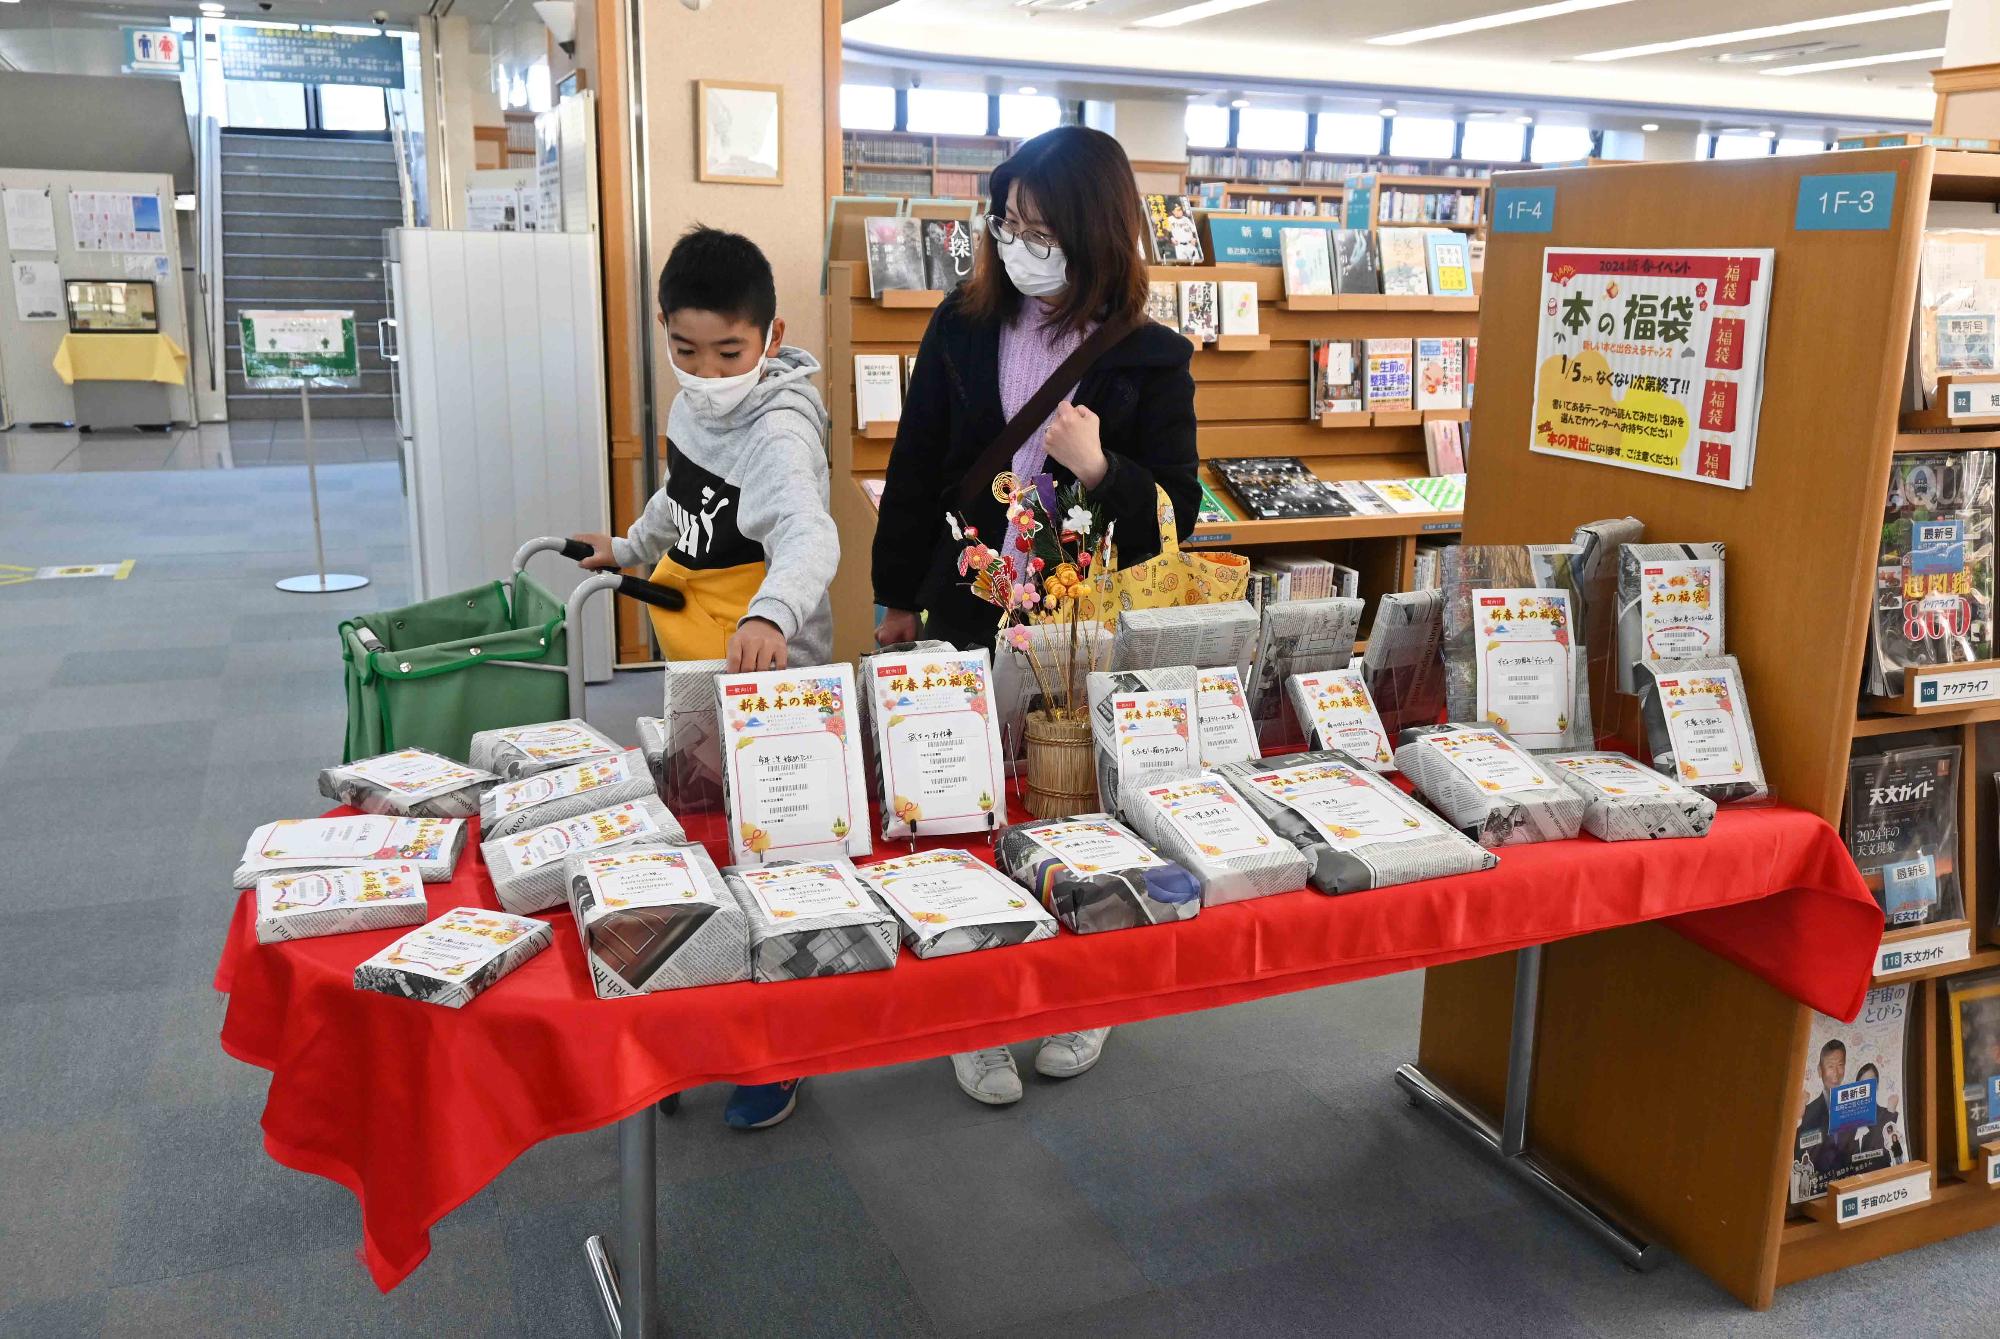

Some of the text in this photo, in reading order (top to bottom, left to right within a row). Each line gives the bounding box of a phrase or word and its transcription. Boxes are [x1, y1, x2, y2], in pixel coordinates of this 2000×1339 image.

[1507, 200, 1543, 219] 1F-4
[1818, 190, 1875, 215] 1F-3
[949, 220, 971, 276] 人探し
[1722, 264, 1740, 301] 福袋
[1561, 290, 1695, 344] 本の福袋
[1951, 320, 1983, 333] 最新号
[1715, 328, 1733, 365] 福袋
[1552, 398, 1685, 428] 書いてあるテーマから読んでみたい包みを
[1708, 390, 1726, 426] 福袋
[1560, 413, 1673, 438] 選んでカウンターへお持ちください
[1924, 527, 1954, 540] 最新号
[1943, 680, 1989, 696] アクアライフ
[1869, 778, 1935, 806] 天文ガイド
[1857, 826, 1900, 843] 2024年の
[1857, 840, 1896, 857] 天文現象
[1896, 863, 1927, 880] 最新号
[1883, 946, 1944, 968] 118 天文ガイド
[1866, 987, 1905, 1007] 宇宙の
[1864, 1002, 1904, 1024] とびら
[1840, 1086, 1868, 1102] 最新号
[1861, 1187, 1908, 1210] 宇宙のとびら
